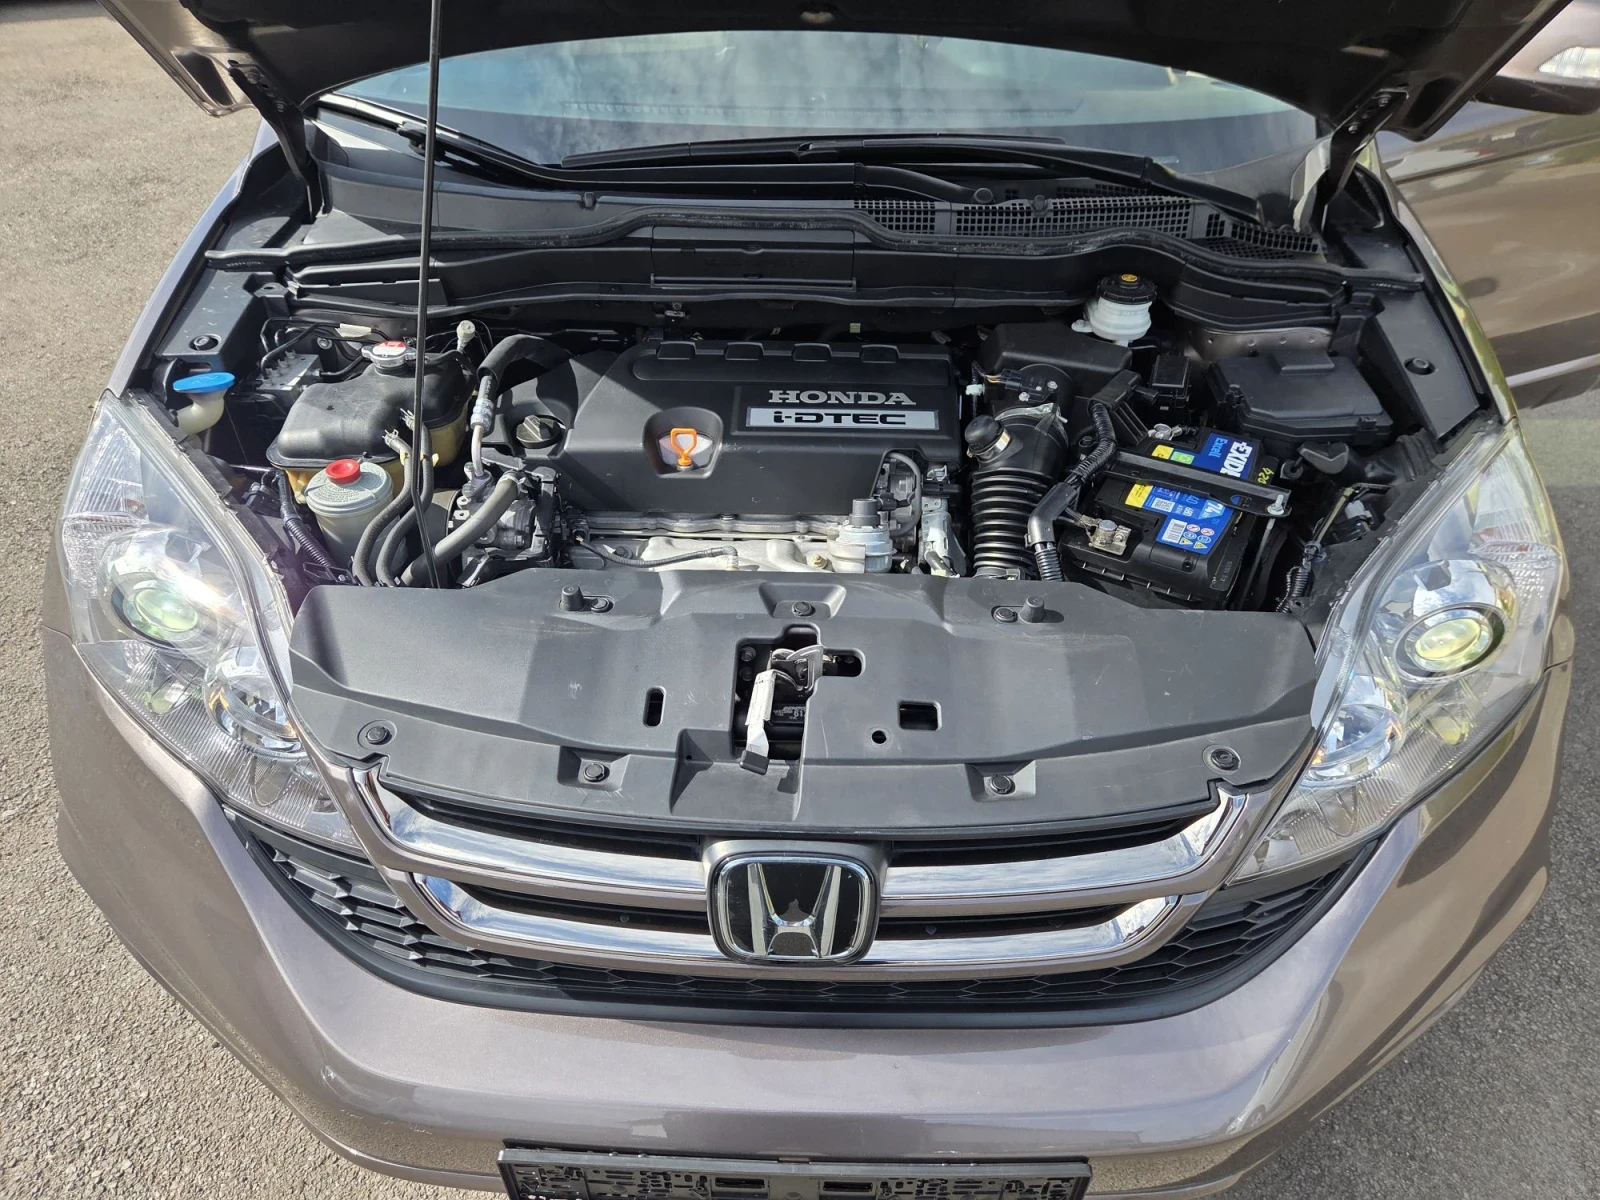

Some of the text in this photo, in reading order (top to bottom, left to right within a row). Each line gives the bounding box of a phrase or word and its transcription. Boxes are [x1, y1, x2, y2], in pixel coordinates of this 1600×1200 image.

[768, 390, 916, 405] HONDA
[773, 411, 906, 425] i-DTEC
[1208, 437, 1228, 458] Excell
[1205, 502, 1224, 514] 74
